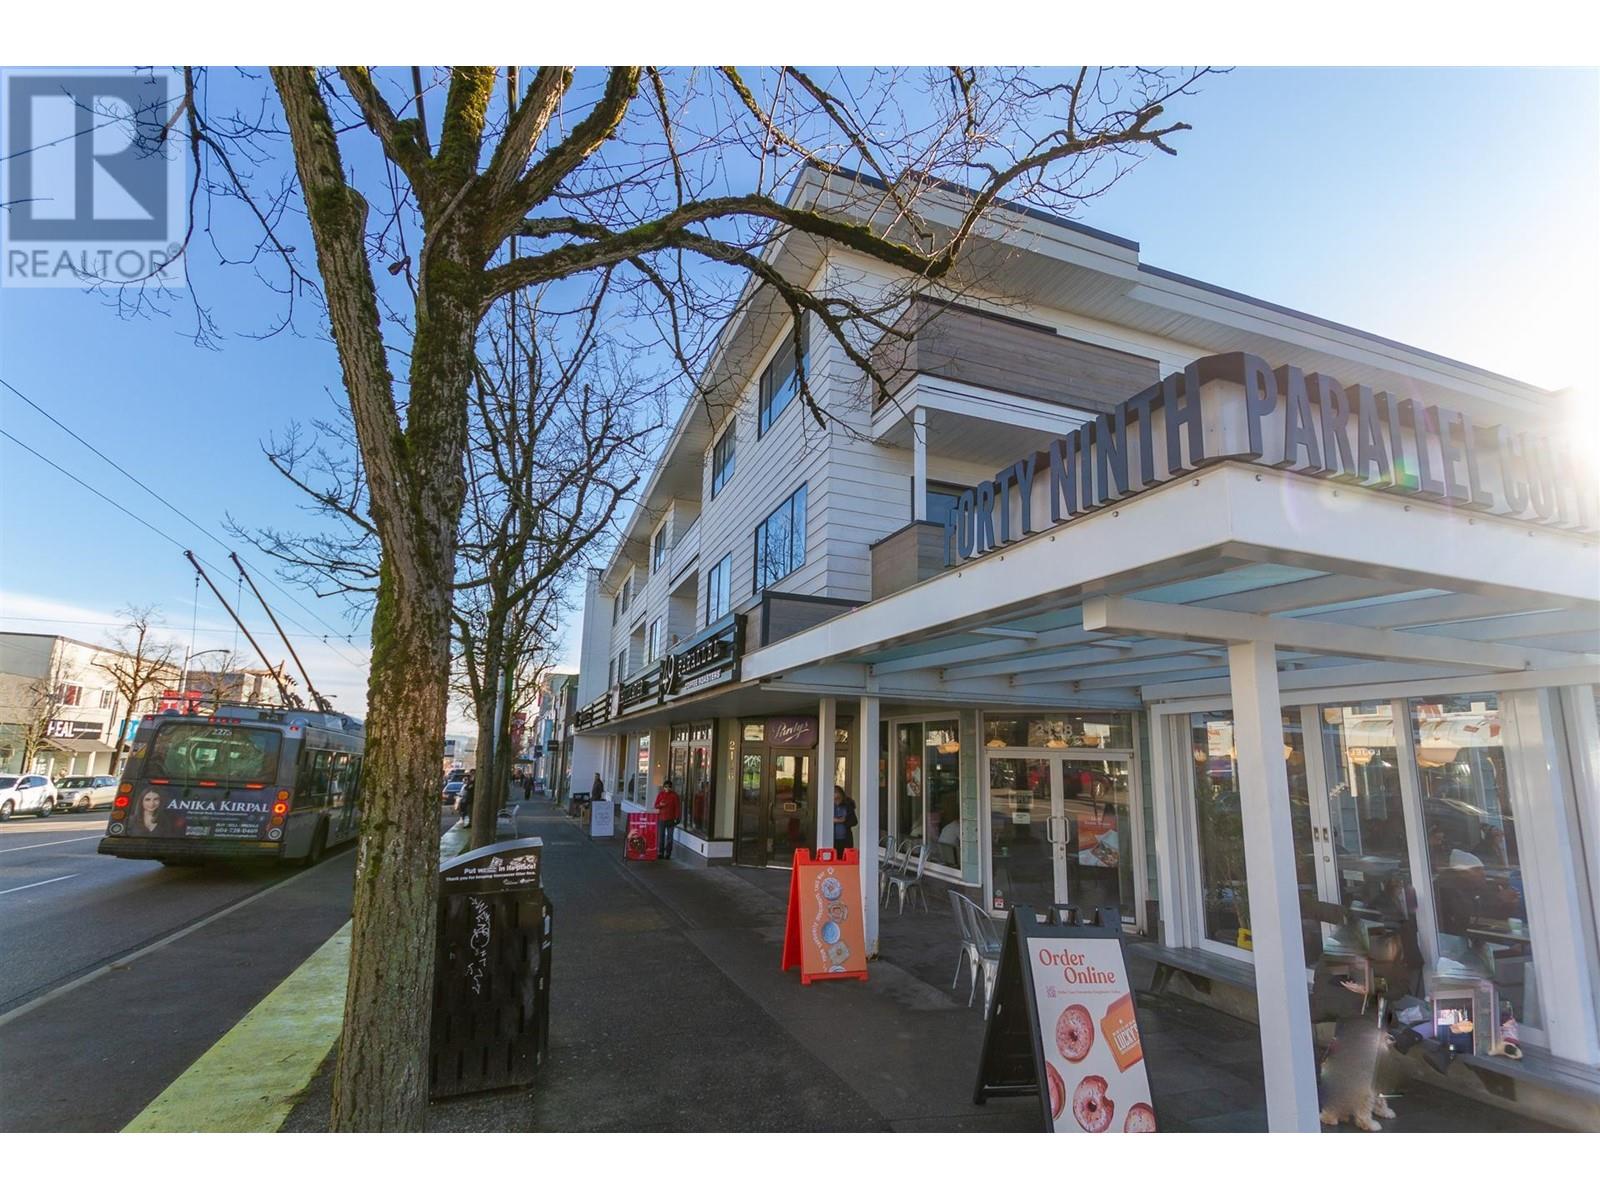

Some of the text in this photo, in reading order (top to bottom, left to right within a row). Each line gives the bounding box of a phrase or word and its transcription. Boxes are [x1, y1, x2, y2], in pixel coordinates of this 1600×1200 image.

[1243, 352, 1493, 508] PARALLEL
[943, 357, 1205, 568] FORTY NINTH
[167, 799, 269, 813] ANIKA KIRPAL
[464, 867, 476, 875] Put
[1039, 948, 1085, 966] Order
[1064, 966, 1117, 985] Online
